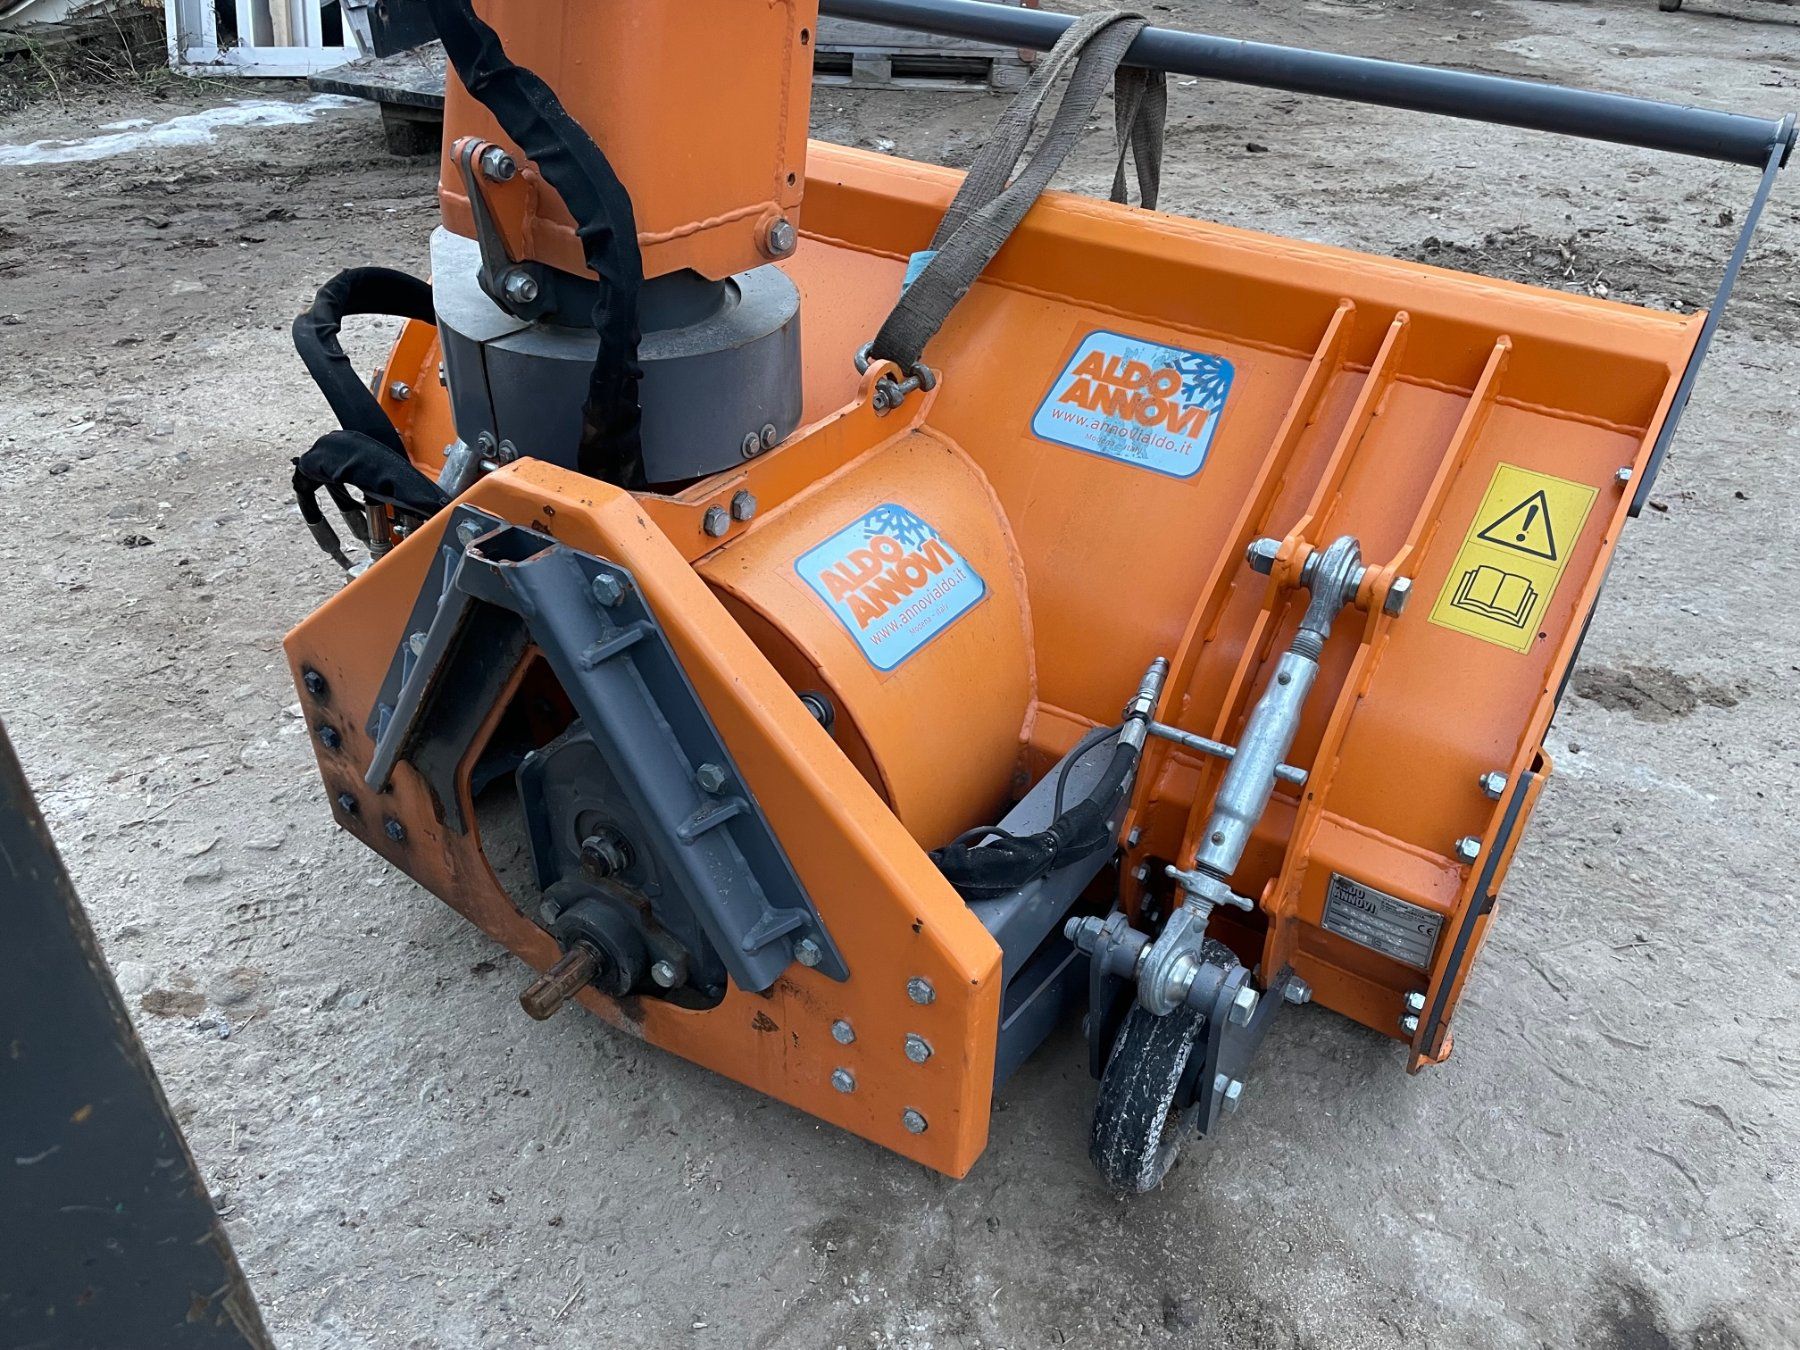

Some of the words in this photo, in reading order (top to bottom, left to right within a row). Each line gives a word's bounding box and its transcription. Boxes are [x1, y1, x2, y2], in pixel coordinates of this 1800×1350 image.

[1072, 350, 1182, 399] ALDO
[1052, 408, 1193, 455] www.annovialdo.it
[1058, 377, 1211, 439] ANNOVI
[818, 536, 904, 604] ALDO
[845, 538, 955, 630] ANNOVI
[869, 567, 967, 646] www.annovialdo.it
[1334, 889, 1377, 914] ANNOVI
[1417, 924, 1434, 937] CE
